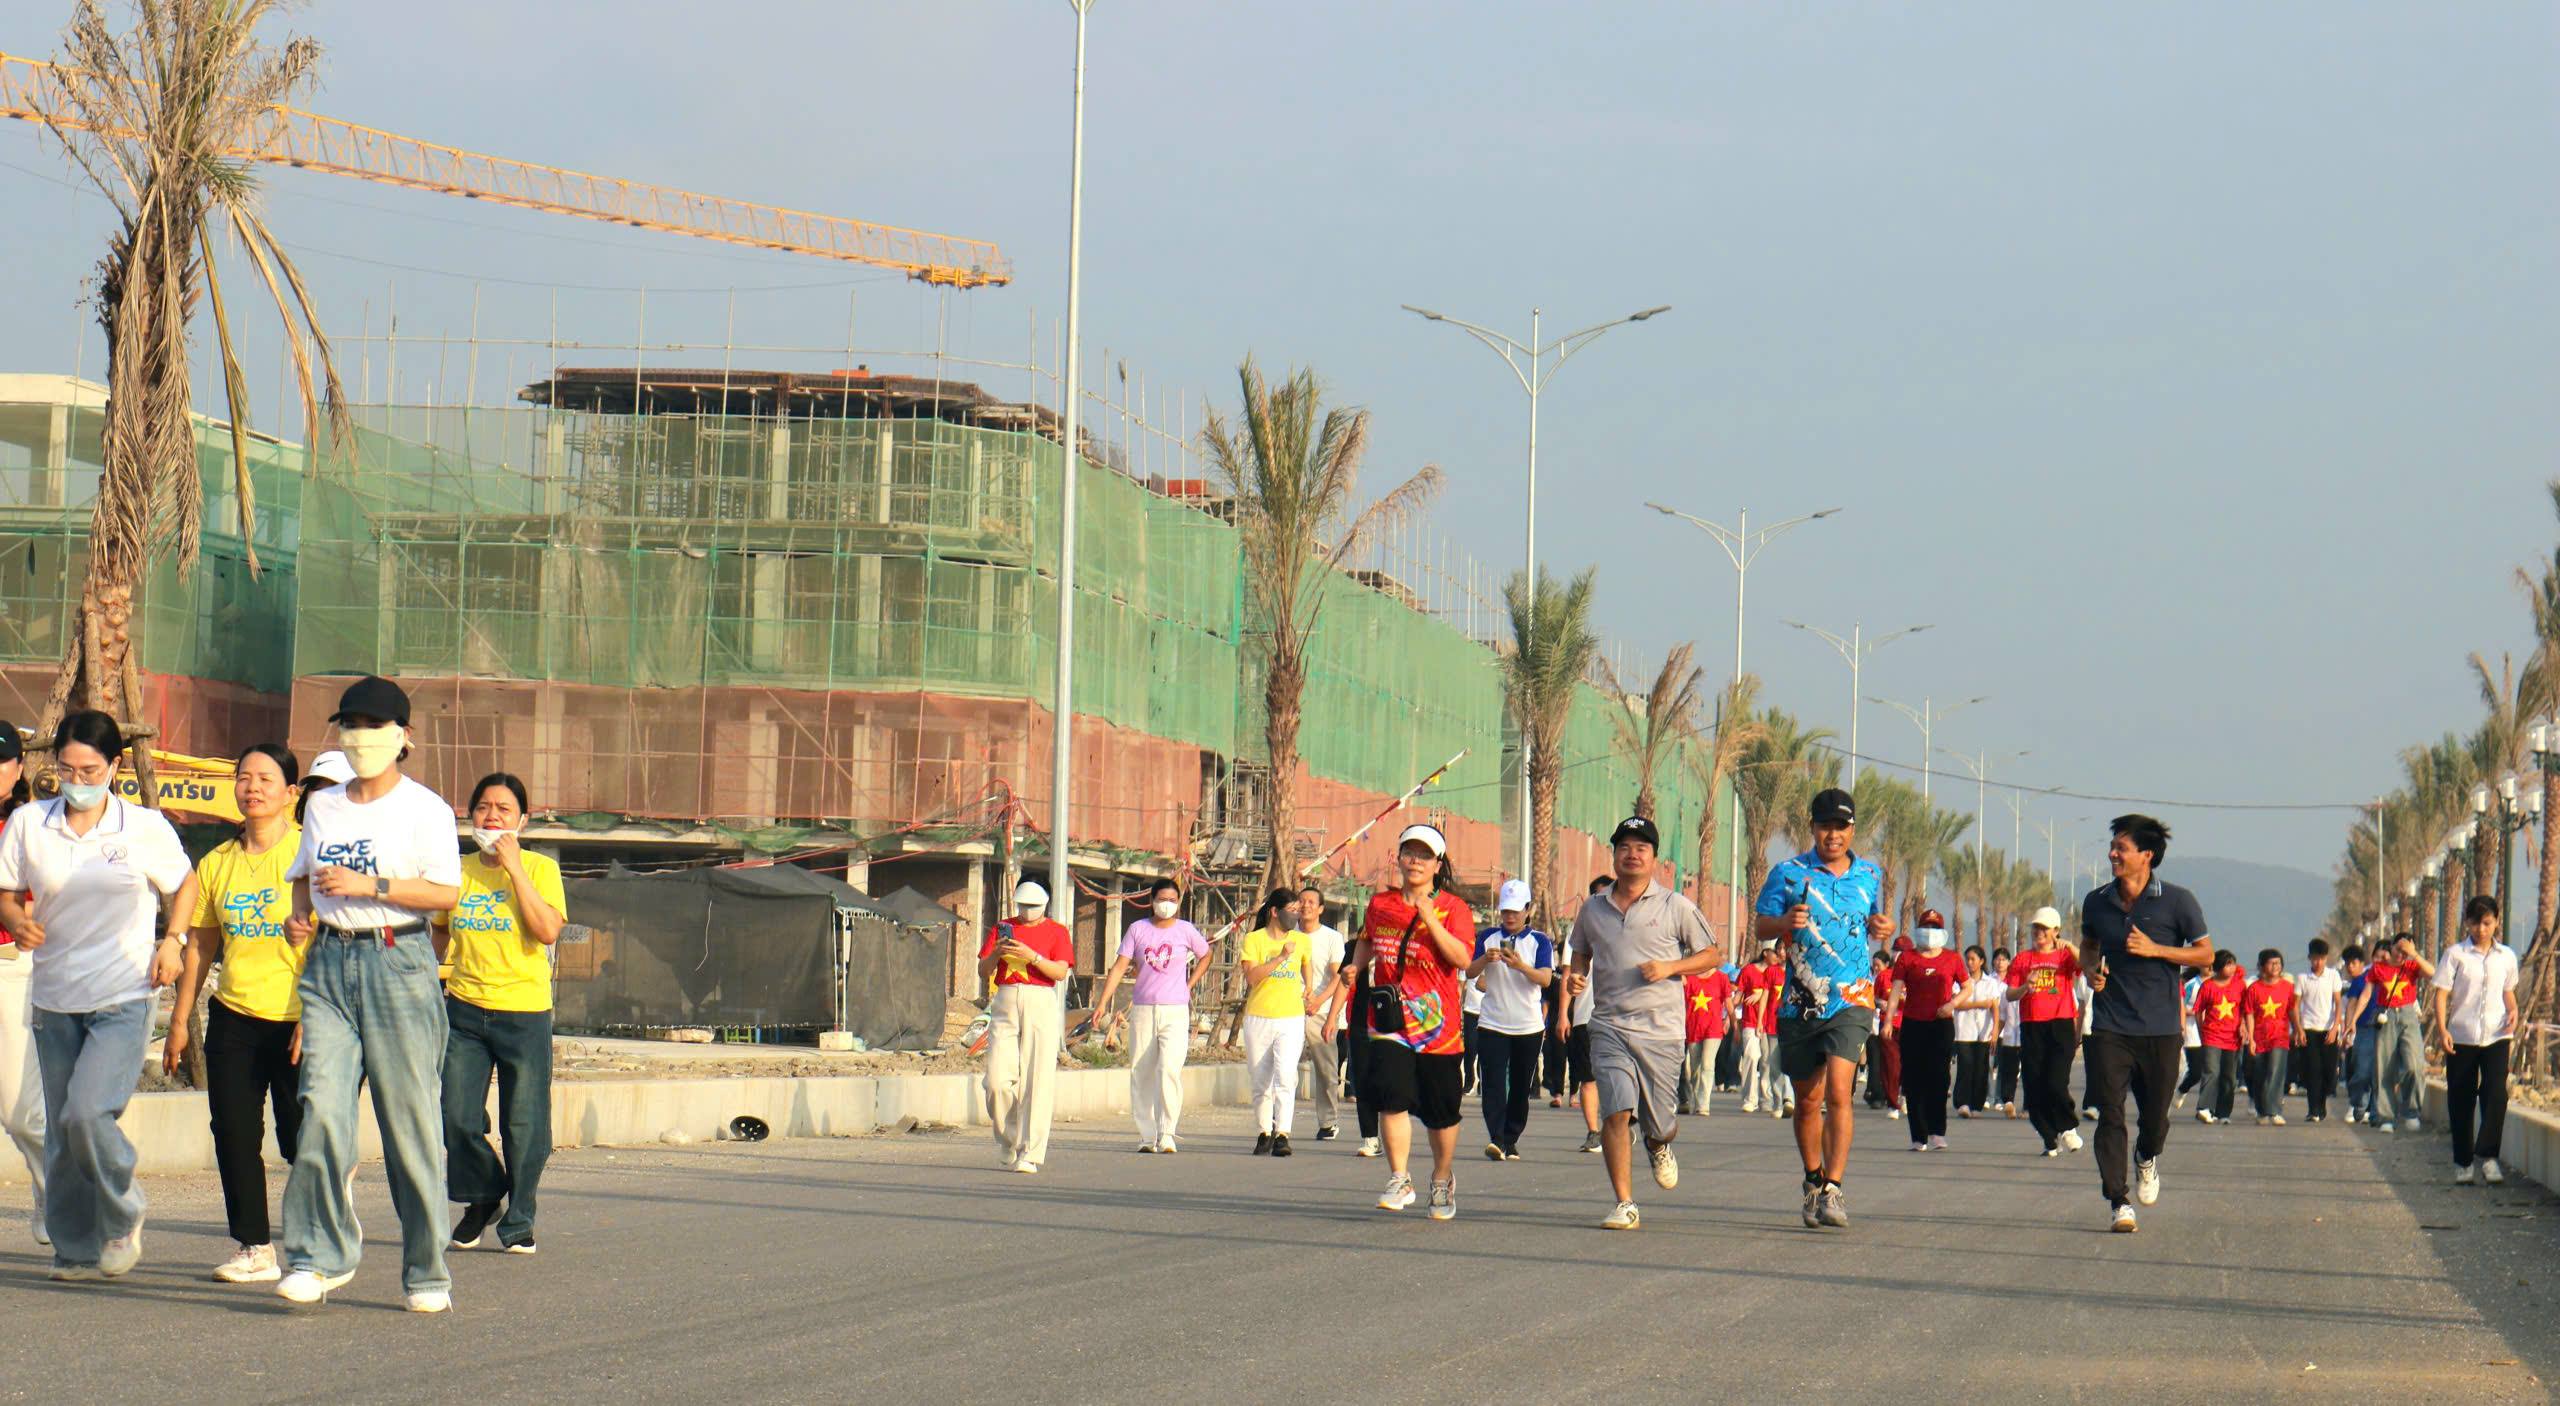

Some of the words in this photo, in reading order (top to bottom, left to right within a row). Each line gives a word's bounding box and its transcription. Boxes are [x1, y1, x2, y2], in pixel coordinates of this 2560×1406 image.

[115, 779, 216, 801] OATSU
[316, 839, 373, 861] LOVE
[328, 855, 379, 875] THEM
[223, 887, 275, 909] LOVE
[459, 889, 506, 907] LOVE
